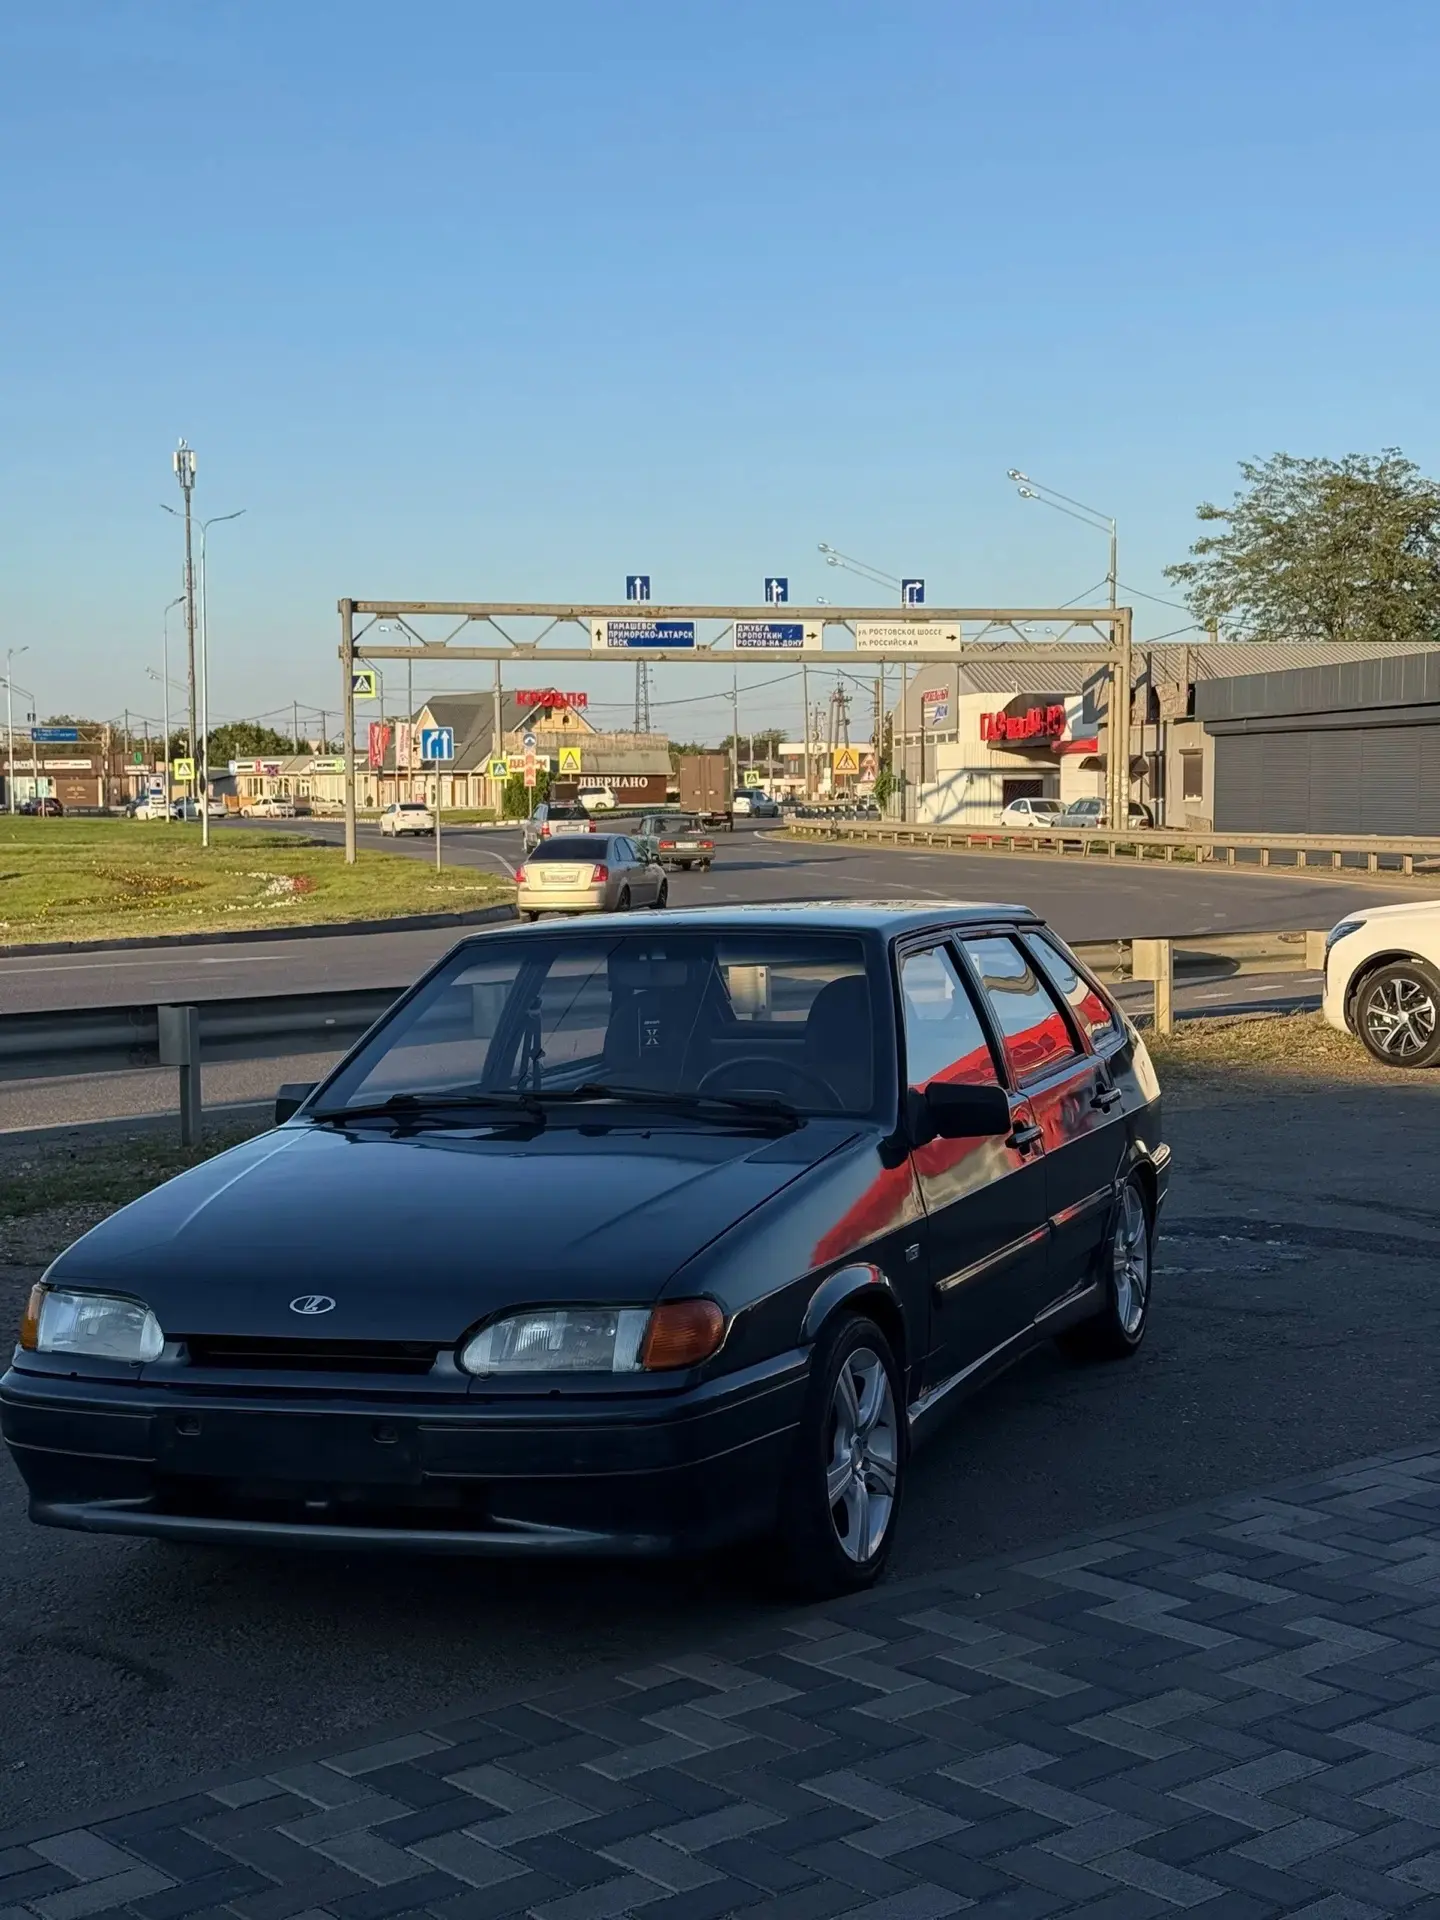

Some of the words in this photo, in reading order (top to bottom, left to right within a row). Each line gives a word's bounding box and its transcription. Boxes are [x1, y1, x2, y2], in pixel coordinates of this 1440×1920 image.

[608, 622, 657, 630] ТИМАШЕВСК
[737, 624, 770, 632] ДЖУБГА
[608, 630, 693, 639] ПРИМОРСКО-АХТАРСК
[869, 628, 916, 636] РОСТОВСКОЕ
[917, 628, 942, 636] ШОССЕ
[608, 638, 629, 647] ЕЙСК
[737, 639, 803, 647] РОСТОВ-НА-ДОНУ
[869, 638, 918, 647] РОССИЙСКАЯ
[578, 776, 649, 788] ДВЕРИАНО
